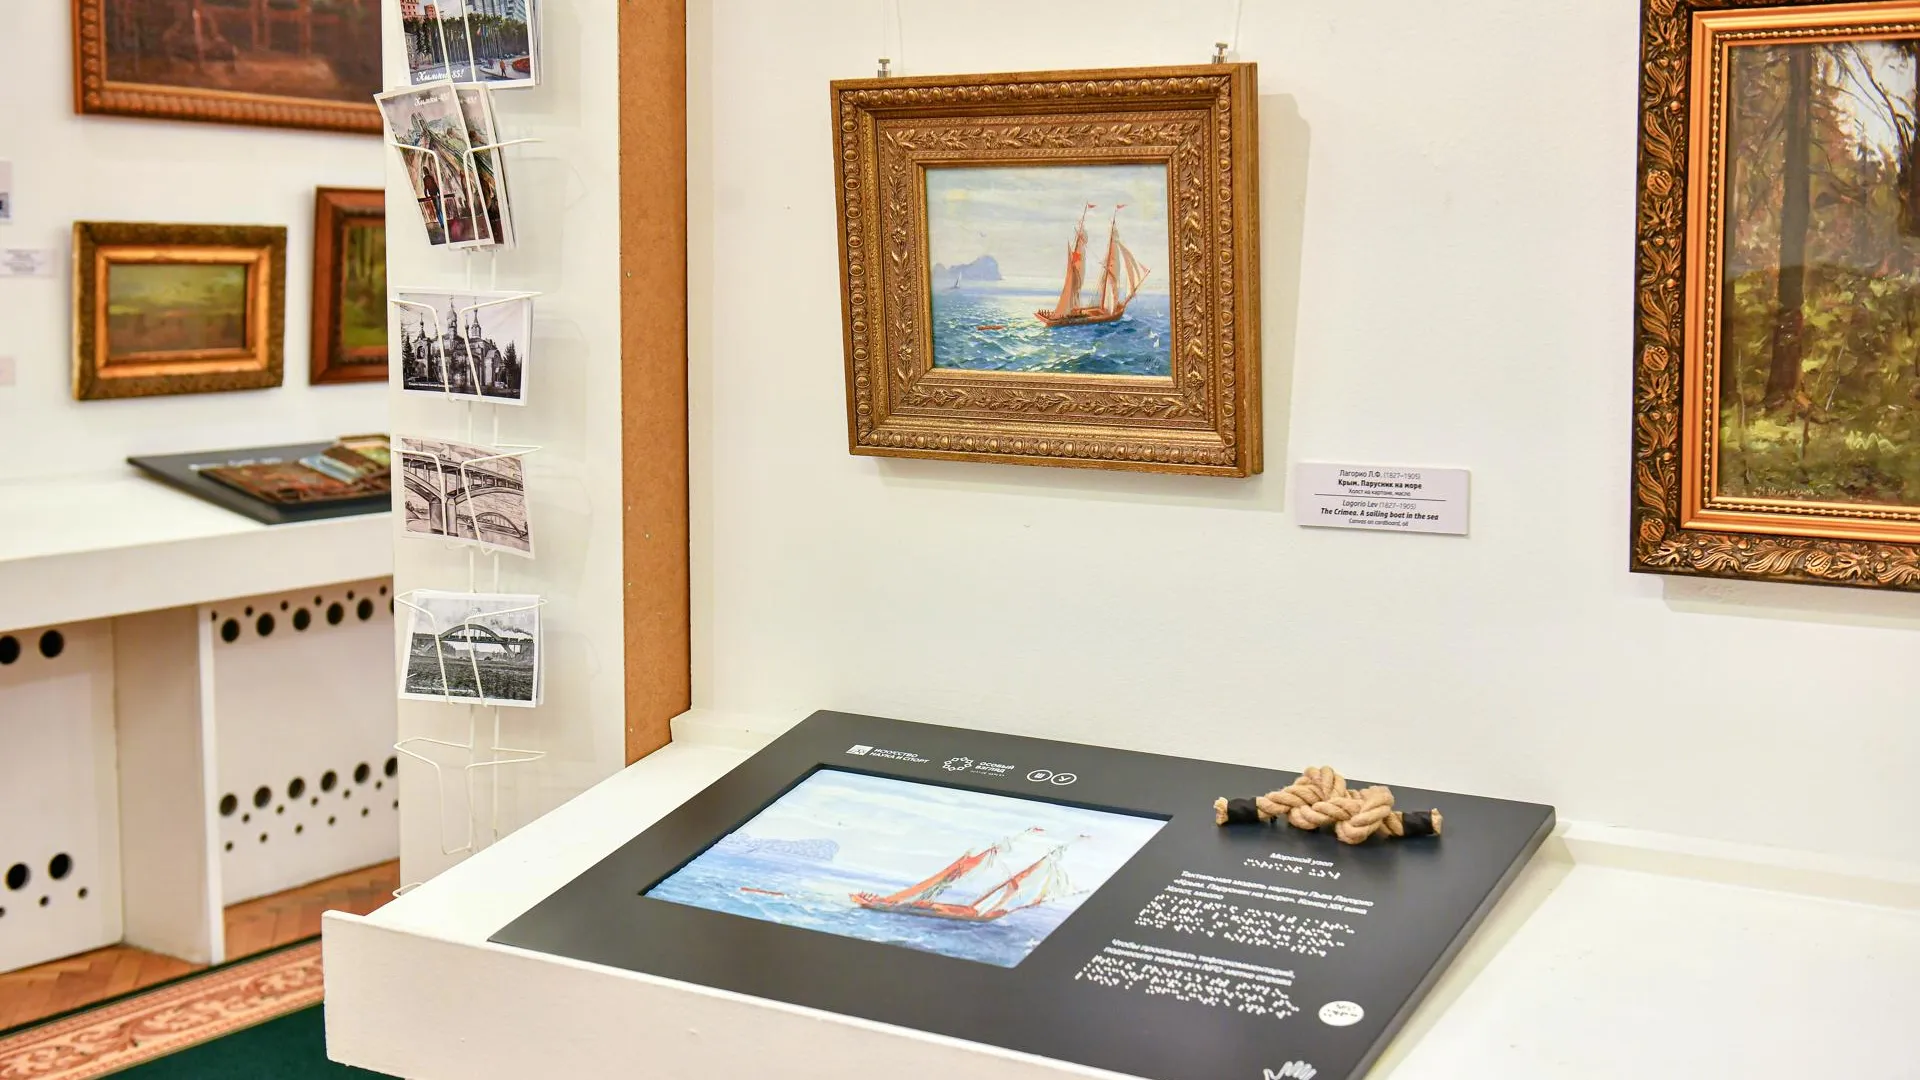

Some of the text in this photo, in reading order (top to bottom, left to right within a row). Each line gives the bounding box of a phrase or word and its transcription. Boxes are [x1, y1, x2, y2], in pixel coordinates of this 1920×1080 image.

[1340, 469, 1367, 478] Лагорио
[1368, 470, 1382, 478] Л.Ф.
[1338, 479, 1360, 487] Крым.
[1361, 479, 1394, 488] Парусник
[1342, 500, 1366, 508] Lagorio
[1367, 500, 1378, 508] Lev
[1321, 507, 1333, 515] The
[1333, 508, 1359, 516] Crimea.
[1366, 510, 1389, 519] sailing
[1406, 511, 1413, 519] in
[1414, 512, 1426, 520] the
